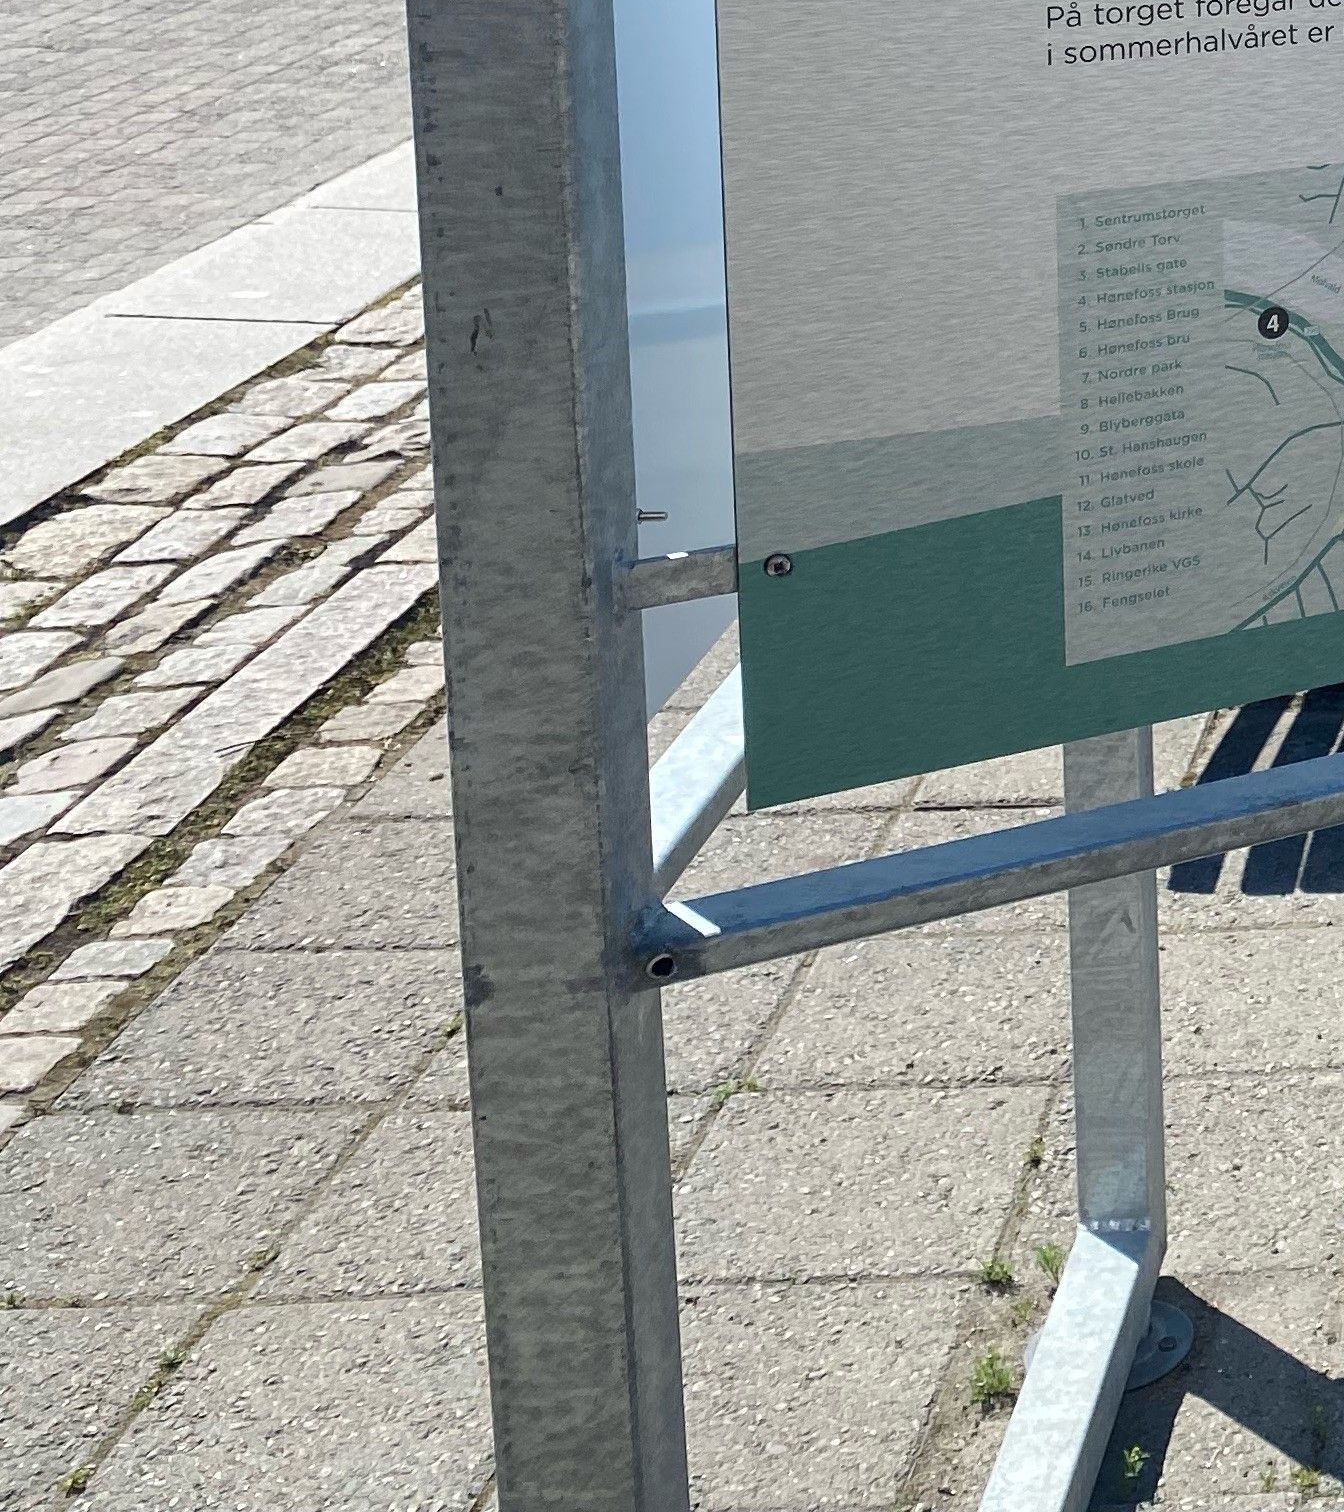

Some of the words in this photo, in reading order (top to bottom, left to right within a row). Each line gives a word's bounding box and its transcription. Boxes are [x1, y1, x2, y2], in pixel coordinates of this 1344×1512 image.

[1046, 1, 1082, 30] På
[1095, 205, 1206, 228] Sentrumstorget
[1095, 236, 1146, 254] Søndre
[1151, 234, 1181, 247] Torv
[1156, 257, 1188, 273] gate
[1096, 287, 1161, 304] Hønefoss
[1166, 280, 1215, 296] stasjon
[1097, 313, 1162, 330] Hønefoss
[1166, 307, 1200, 321] Brug
[1098, 339, 1163, 356] Hønefoss
[1167, 333, 1190, 346] bru
[1098, 365, 1147, 383] Nordre
[1151, 359, 1183, 374] park
[1100, 465, 1165, 483] Hønefoss
[1168, 456, 1204, 472] skole
[1101, 515, 1165, 534] Hønefoss
[1169, 506, 1203, 520] kirke
[1172, 554, 1200, 570] VGS
